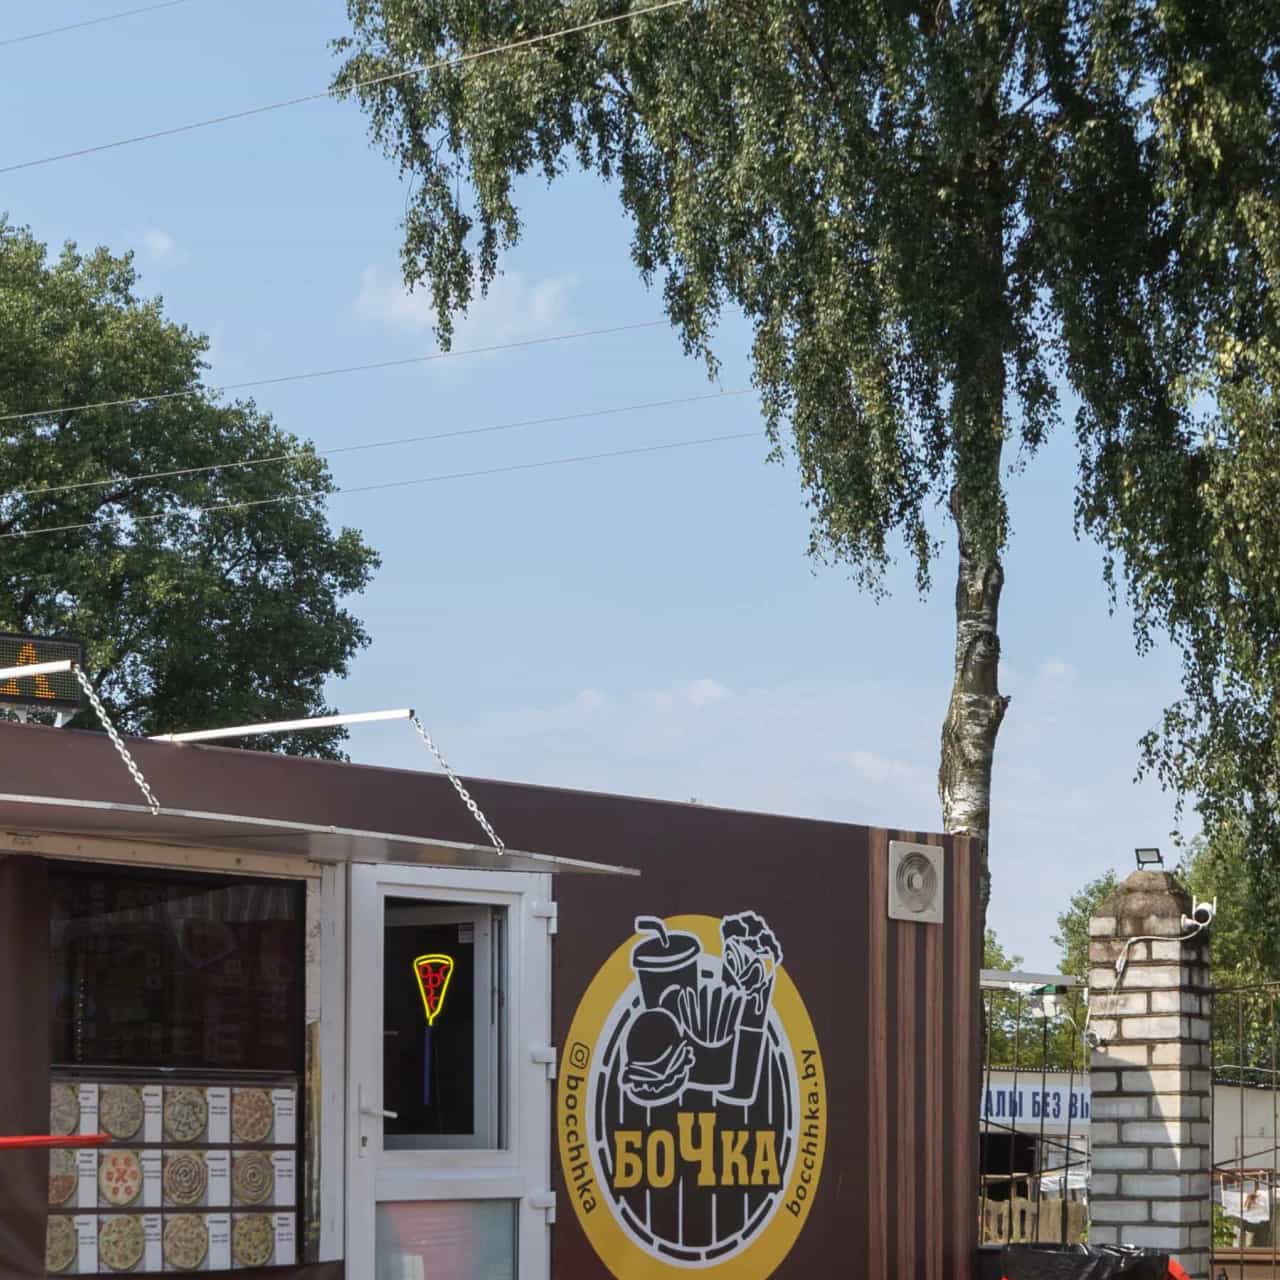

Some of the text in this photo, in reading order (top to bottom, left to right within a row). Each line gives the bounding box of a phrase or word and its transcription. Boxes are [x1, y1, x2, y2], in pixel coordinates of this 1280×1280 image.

[565, 1074, 597, 1215] bocchhka
[614, 1112, 781, 1188] БОЧКА
[785, 1049, 821, 1218] bocchhka.by
[1032, 1091, 1061, 1119] БЕЗ
